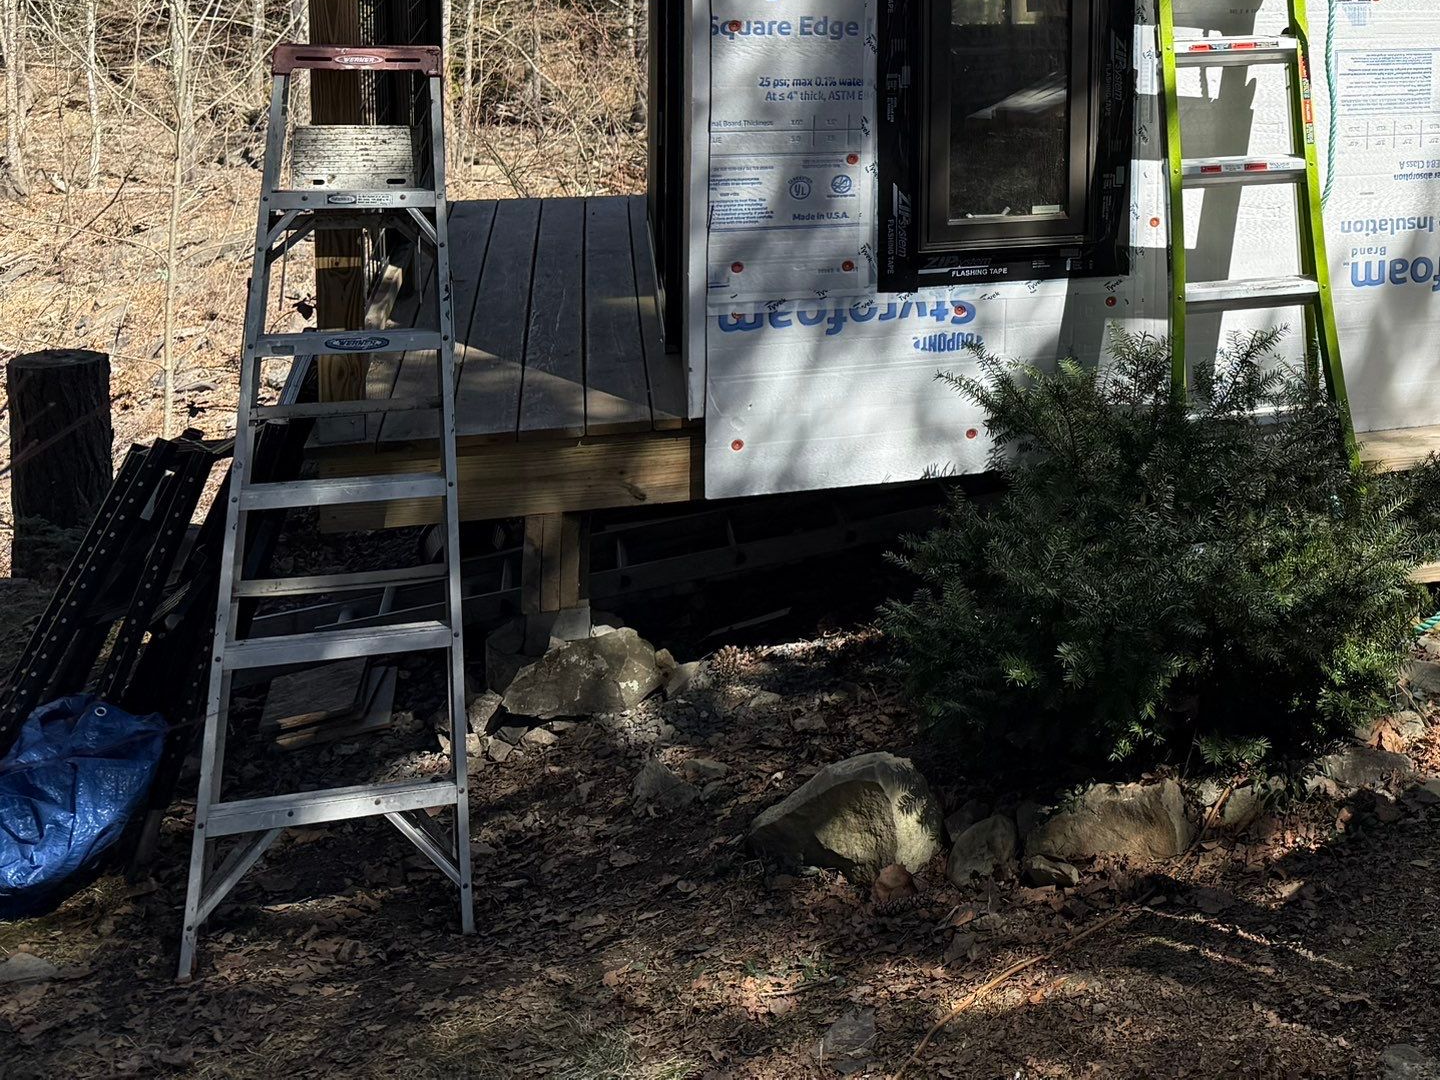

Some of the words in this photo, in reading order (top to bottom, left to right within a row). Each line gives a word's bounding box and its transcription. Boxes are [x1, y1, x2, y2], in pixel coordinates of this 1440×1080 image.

[800, 16, 859, 40] Edge
[865, 34, 878, 55] Tyvek
[758, 77, 770, 87] 25
[792, 78, 813, 86] max
[815, 77, 836, 87] 0.1%
[765, 91, 777, 101] At
[799, 91, 826, 102] thick,
[828, 91, 855, 101] ASTM
[1407, 160, 1424, 168] Class
[1425, 159, 1440, 167] E84
[1393, 171, 1433, 180] absorption
[793, 213, 816, 221] Made
[827, 211, 849, 219] U.S.A.
[1340, 216, 1433, 236] Insulation
[887, 219, 895, 254] FLASHING
[861, 243, 873, 264] Tyvek
[1351, 246, 1386, 257] Brand
[951, 269, 988, 278] FLASHING
[990, 267, 1008, 275] TAPE
[1104, 279, 1122, 293] Tyvek
[764, 297, 787, 313] Tyvek
